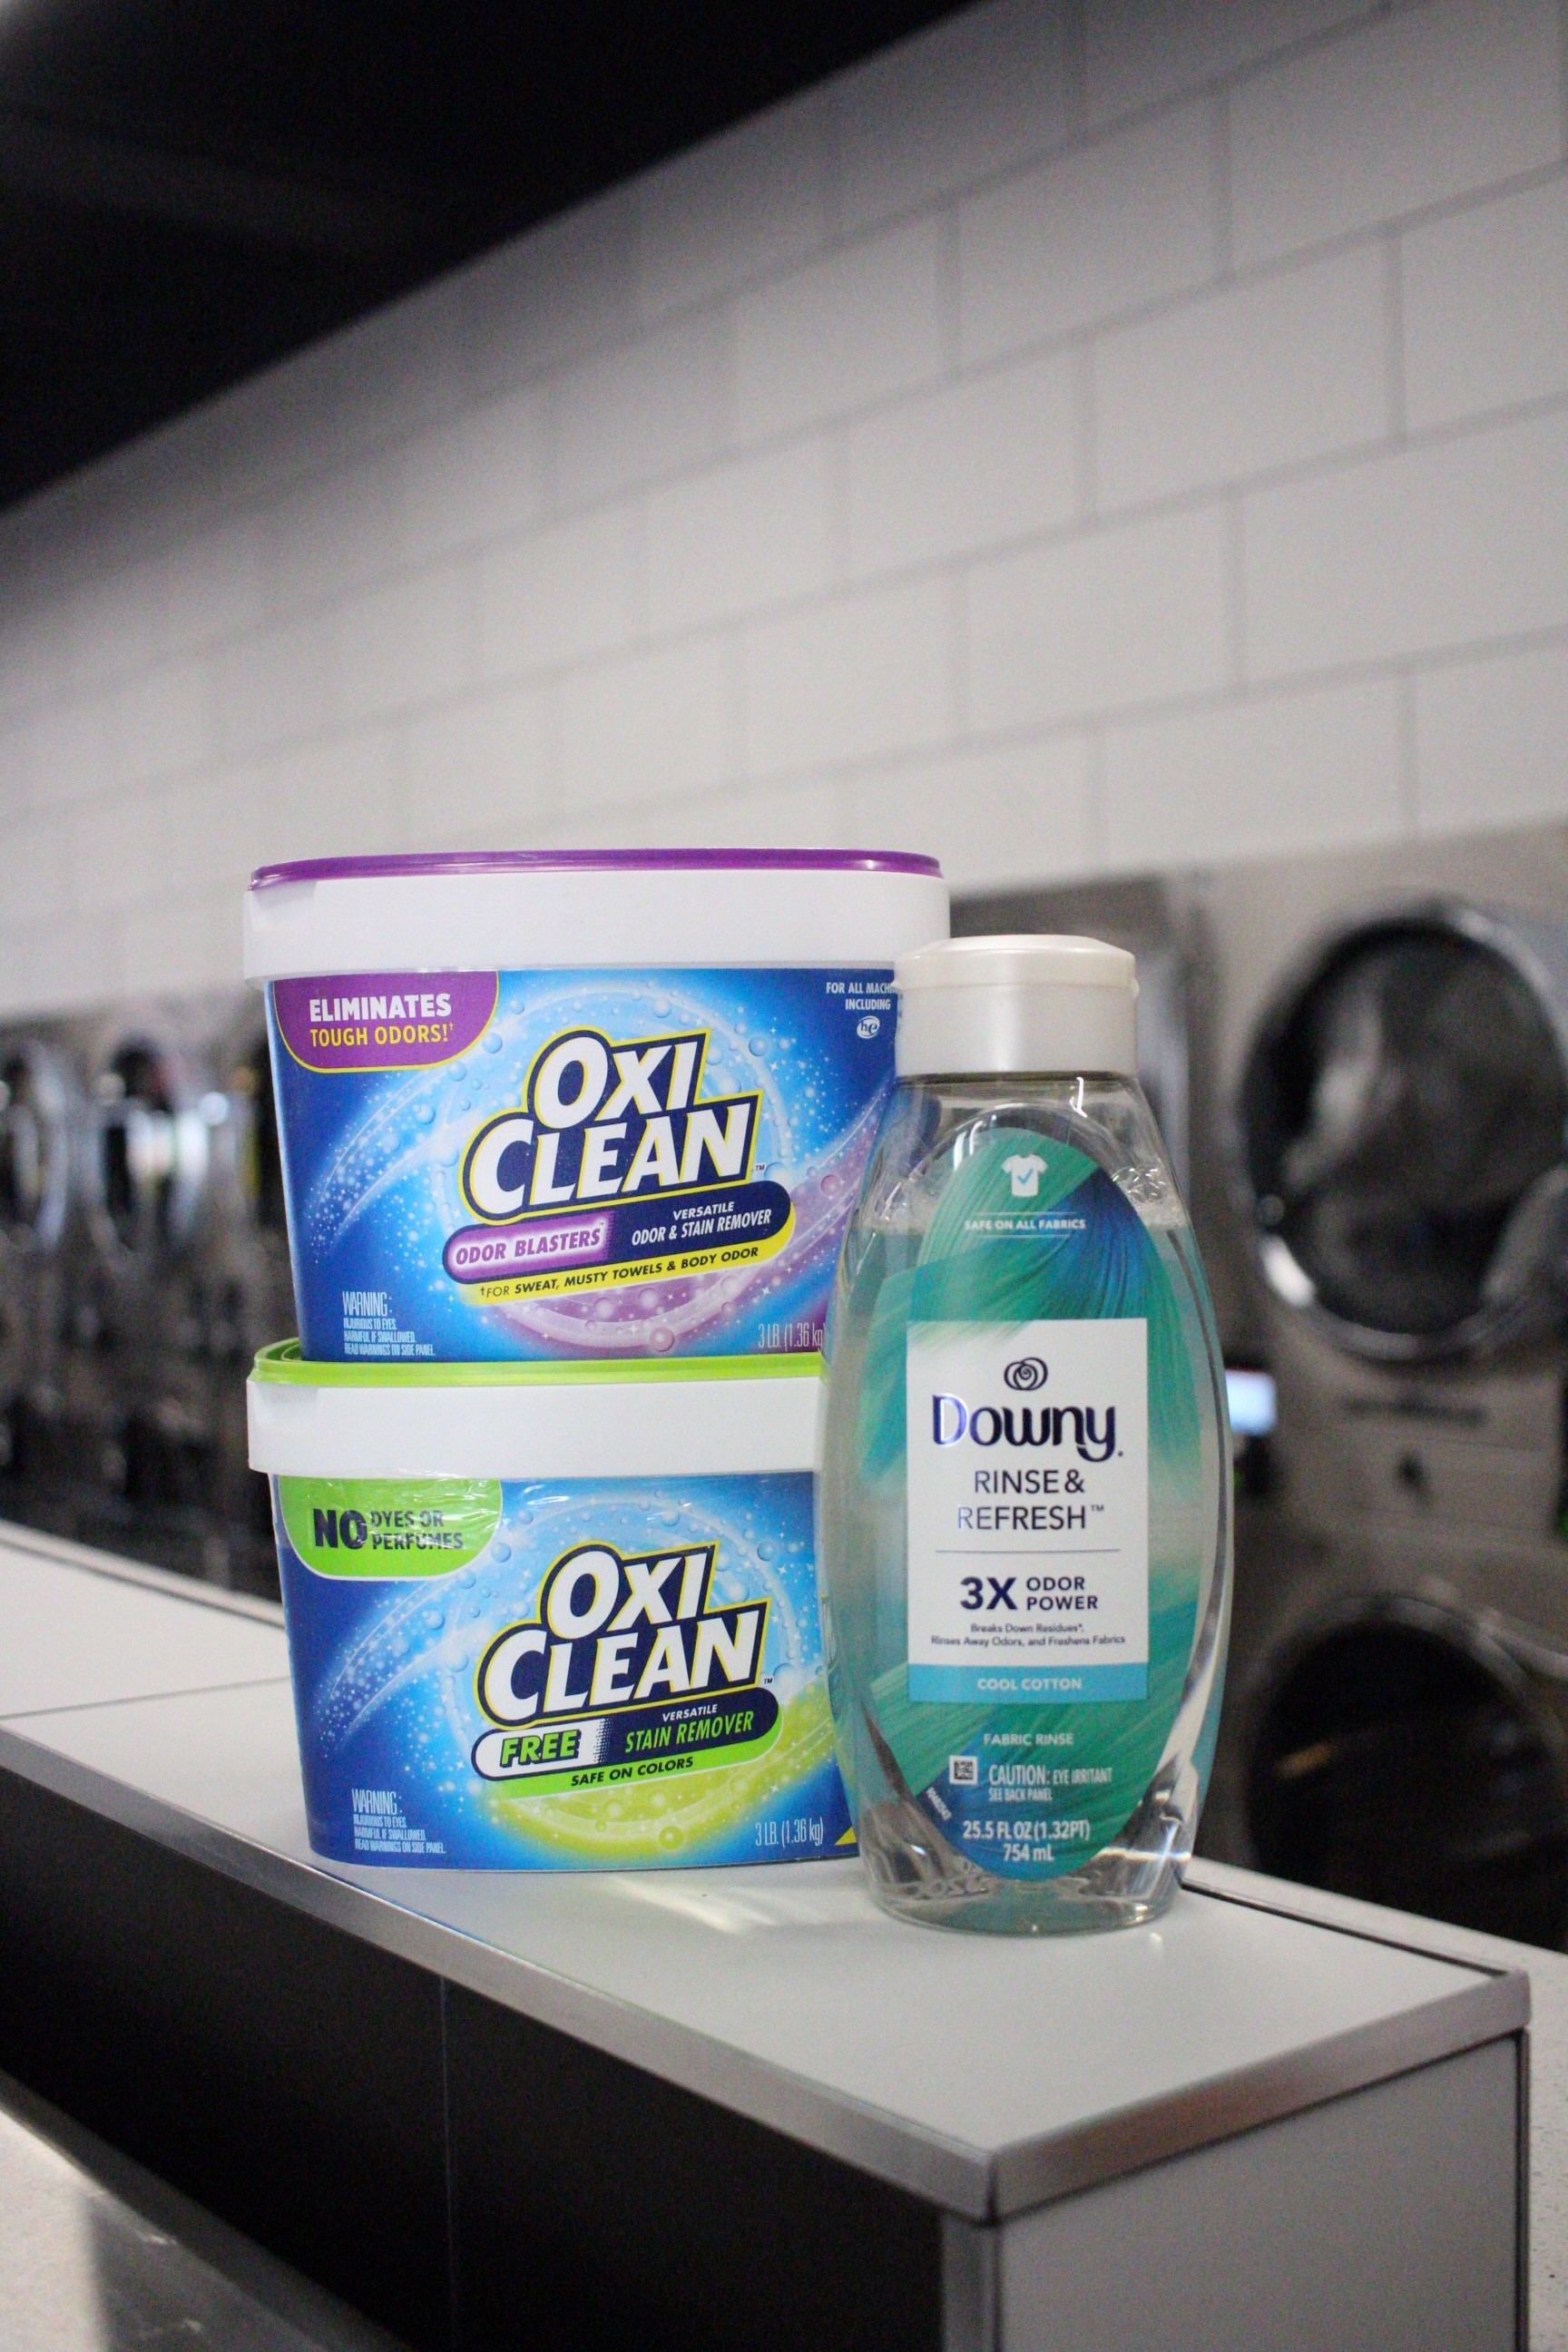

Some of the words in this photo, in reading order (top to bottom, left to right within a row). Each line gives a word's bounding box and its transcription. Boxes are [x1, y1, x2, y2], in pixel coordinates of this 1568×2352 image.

[825, 982, 845, 994] FOR
[848, 982, 864, 994] ALL
[309, 993, 452, 1022] ELIMINATES
[845, 999, 891, 1010] INCLUDING
[310, 1027, 368, 1047] TOUGH
[534, 1036, 698, 1130] OXI
[468, 1102, 751, 1214] CLEAN
[672, 1201, 734, 1220] VERSATILE
[632, 1226, 665, 1246] ODOR
[669, 1224, 678, 1240] &
[681, 1217, 713, 1239] STAIN
[717, 1208, 772, 1230] REMOVER
[965, 1220, 993, 1230] SAFE
[995, 1220, 1013, 1230] ON
[1015, 1220, 1036, 1230] ALL
[1038, 1219, 1086, 1230] FABRICS
[455, 1242, 505, 1267] ODOR
[514, 1279, 560, 1295] SWEAT,
[564, 1271, 607, 1288] MUSTY
[612, 1262, 662, 1280] TOWELS
[667, 1259, 676, 1272] &
[681, 1253, 717, 1269] BODY
[721, 1247, 759, 1263] ODOR
[342, 1290, 392, 1317] WARNING:
[758, 1324, 765, 1348] 3
[768, 1324, 781, 1348] LB.
[932, 1393, 1116, 1463] Downy
[974, 1470, 1059, 1494] RINSE
[1064, 1468, 1085, 1494] &
[313, 1508, 368, 1549] NO
[370, 1510, 414, 1527] DYES
[419, 1510, 445, 1527] OR
[372, 1532, 464, 1550] PERFUMES
[546, 1550, 707, 1640] OXI
[960, 1576, 1018, 1611] 3X
[1026, 1575, 1085, 1592] ODOR
[1026, 1595, 1099, 1611] POWER
[971, 1622, 1003, 1633] Breaks
[1004, 1622, 1034, 1633] Down
[931, 1635, 960, 1646] Rinses
[963, 1636, 989, 1648] Away
[992, 1635, 1025, 1647] Odors,
[1027, 1635, 1045, 1646] and
[1048, 1635, 1090, 1646] Freshens
[1093, 1634, 1125, 1645] Fabrics
[484, 1610, 760, 1720] CLEAN
[977, 1678, 1017, 1690] COOL
[1021, 1678, 1083, 1690] COTTON
[662, 1703, 718, 1722] VERSATILE
[625, 1727, 671, 1754] STAIN
[676, 1710, 754, 1744] REMOVER
[984, 1733, 1032, 1746] FABRIC
[1035, 1732, 1074, 1746] RINSE
[500, 1729, 581, 1768] FREE
[571, 1771, 605, 1788] SAFE
[609, 1767, 632, 1781] ON
[637, 1756, 693, 1777] COLORS
[988, 1764, 1051, 1786] CAUTION:
[1054, 1769, 1069, 1785] EYE
[351, 1788, 402, 1815] WARNING:
[988, 1788, 1003, 1801] SEE
[755, 1822, 762, 1847] 3
[764, 1821, 779, 1845] LB.
[781, 1818, 807, 1847] (1.36
[809, 1817, 824, 1847] kg)
[963, 1819, 995, 1839] 25.5
[996, 1819, 1012, 1839] FL
[1014, 1819, 1033, 1839] OZ
[1004, 1843, 1031, 1861] 754
[1033, 1843, 1054, 1861] mL
